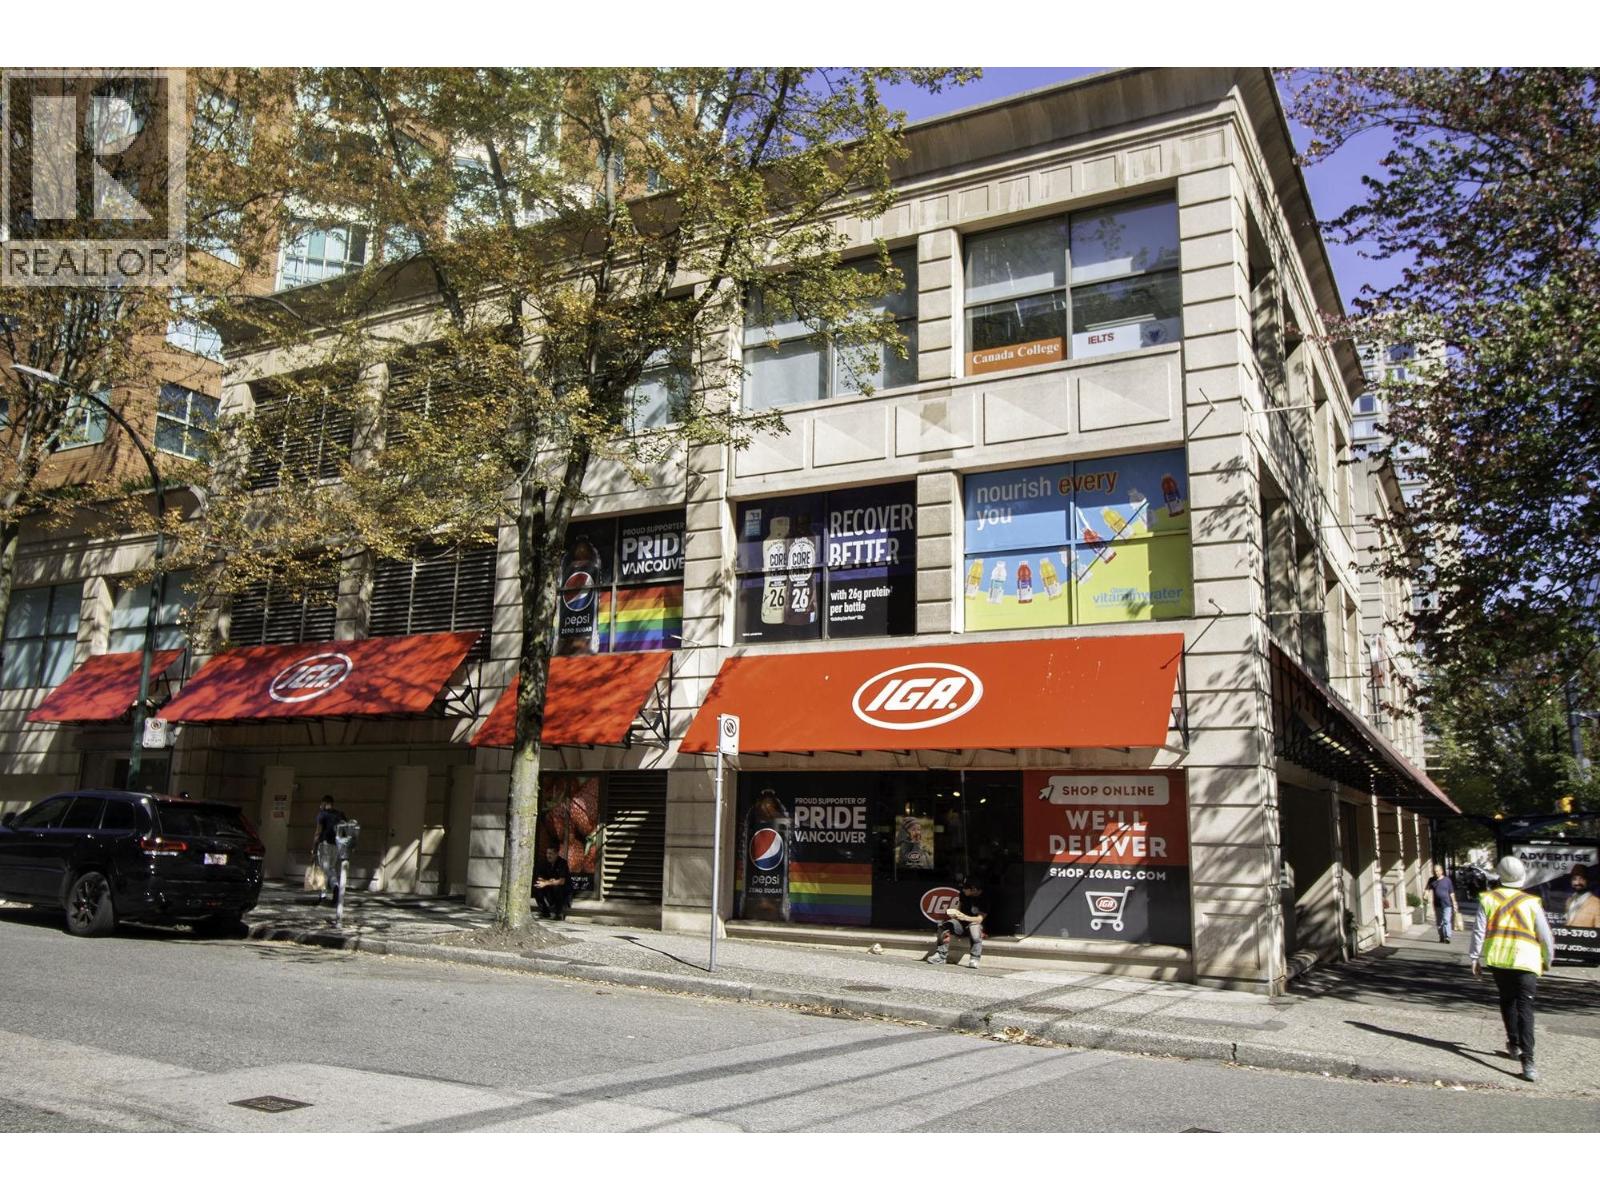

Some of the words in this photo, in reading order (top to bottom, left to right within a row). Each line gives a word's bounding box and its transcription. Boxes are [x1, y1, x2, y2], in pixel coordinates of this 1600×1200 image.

[1087, 332, 1115, 345] IELTS
[972, 349, 1014, 366] Canada
[1017, 342, 1060, 360] College
[976, 476, 1051, 504] nourish
[1058, 470, 1118, 497] every
[829, 503, 914, 538] RECOVER
[976, 506, 1012, 531] you
[622, 526, 646, 537] PROUD
[792, 551, 811, 566] CORE
[828, 537, 900, 570] BETTER
[830, 589, 847, 601] with
[848, 587, 863, 601] 26g
[1092, 587, 1184, 605] vitaminwater
[829, 603, 842, 616] per
[843, 601, 866, 613] bottle
[564, 613, 590, 627] pepsi
[1062, 785, 1098, 796] SHOP
[1103, 785, 1155, 797] ONLINE
[794, 796, 817, 805] PROUD
[818, 796, 855, 805] SUPPORTER
[856, 796, 867, 805] OF
[794, 805, 867, 831] PRIDE
[1065, 809, 1147, 832] WE'LL
[794, 830, 866, 845] VANCOUVER
[1049, 835, 1168, 858] DELIVER
[1520, 852, 1591, 863] ADVERTISE
[1049, 867, 1167, 882] SHOP.IGABC.COM
[1552, 863, 1568, 871] US
[751, 873, 780, 887] pepsi
[1098, 898, 1115, 909] IGA
